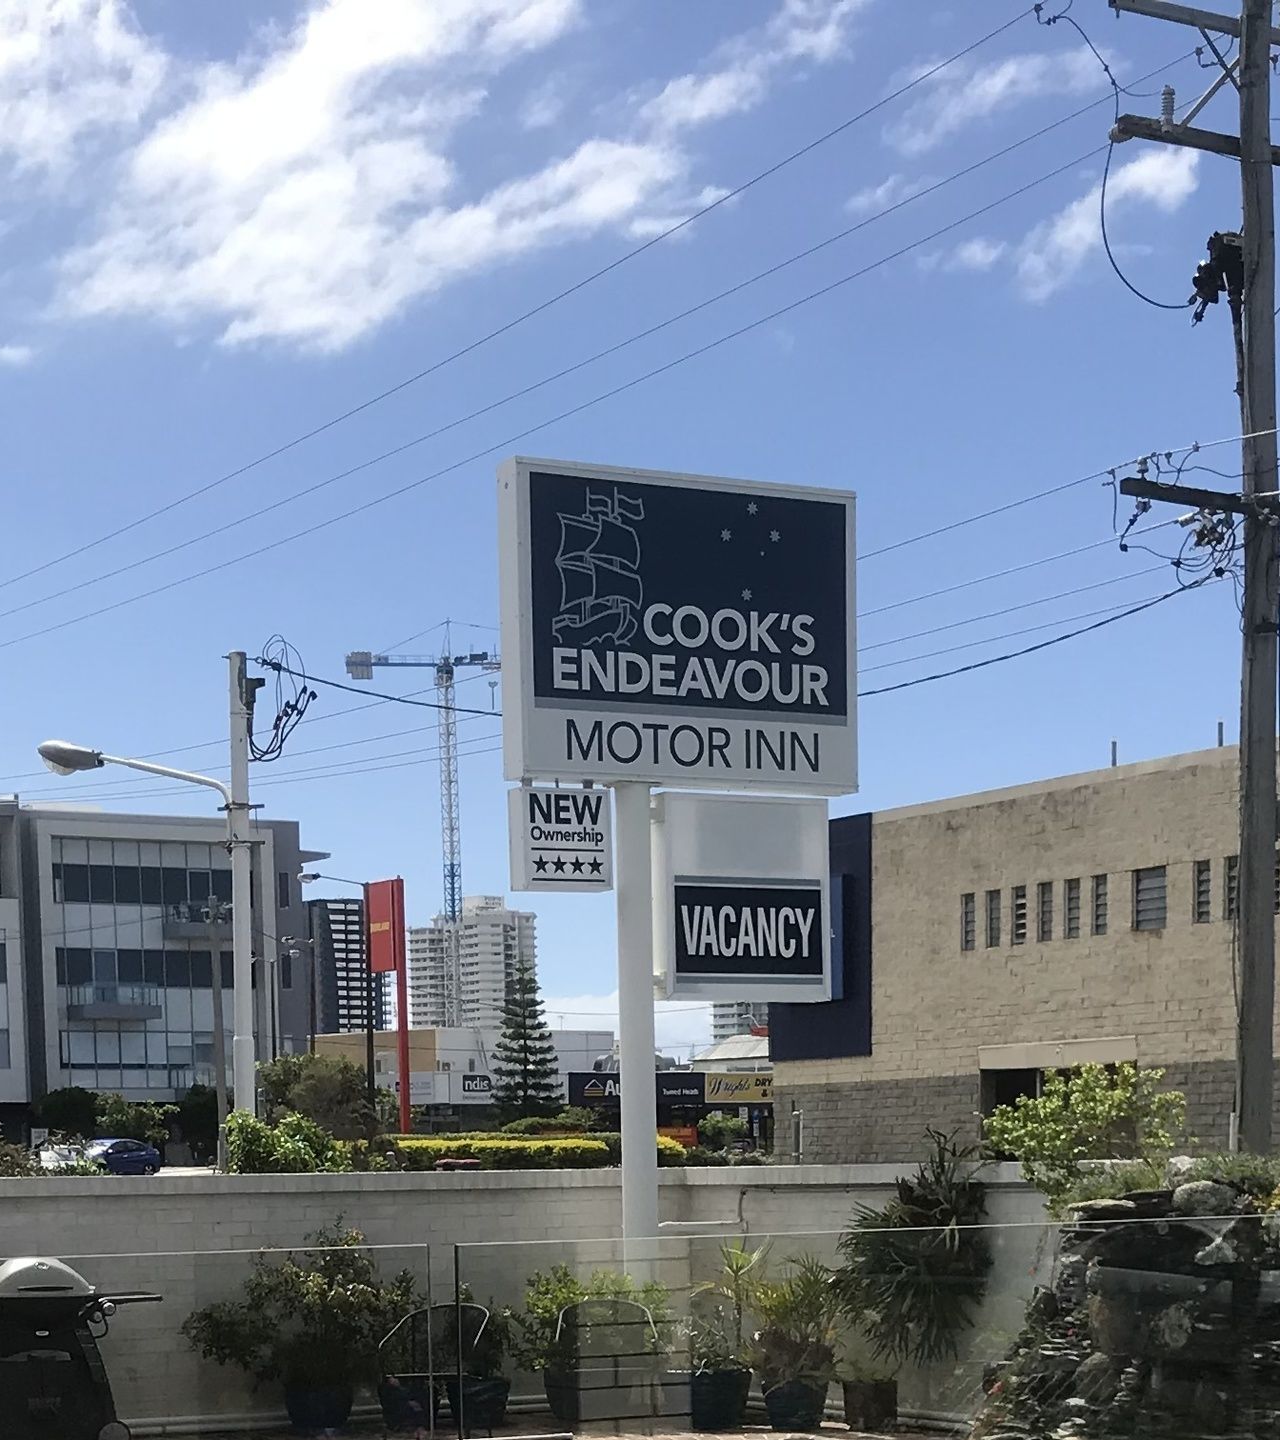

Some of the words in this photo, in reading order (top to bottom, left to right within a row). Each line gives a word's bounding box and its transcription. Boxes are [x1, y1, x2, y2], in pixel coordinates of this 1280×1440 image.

[643, 602, 815, 656] COOK'S
[552, 646, 829, 706] ENDEAVOUR
[565, 718, 732, 768] MOTOR
[744, 728, 819, 773] INN
[528, 792, 603, 826] NEW
[530, 826, 604, 847] Ownership
[680, 904, 816, 959] VACANCY
[465, 1076, 489, 1090] ndis
[754, 1077, 773, 1087] DRY
